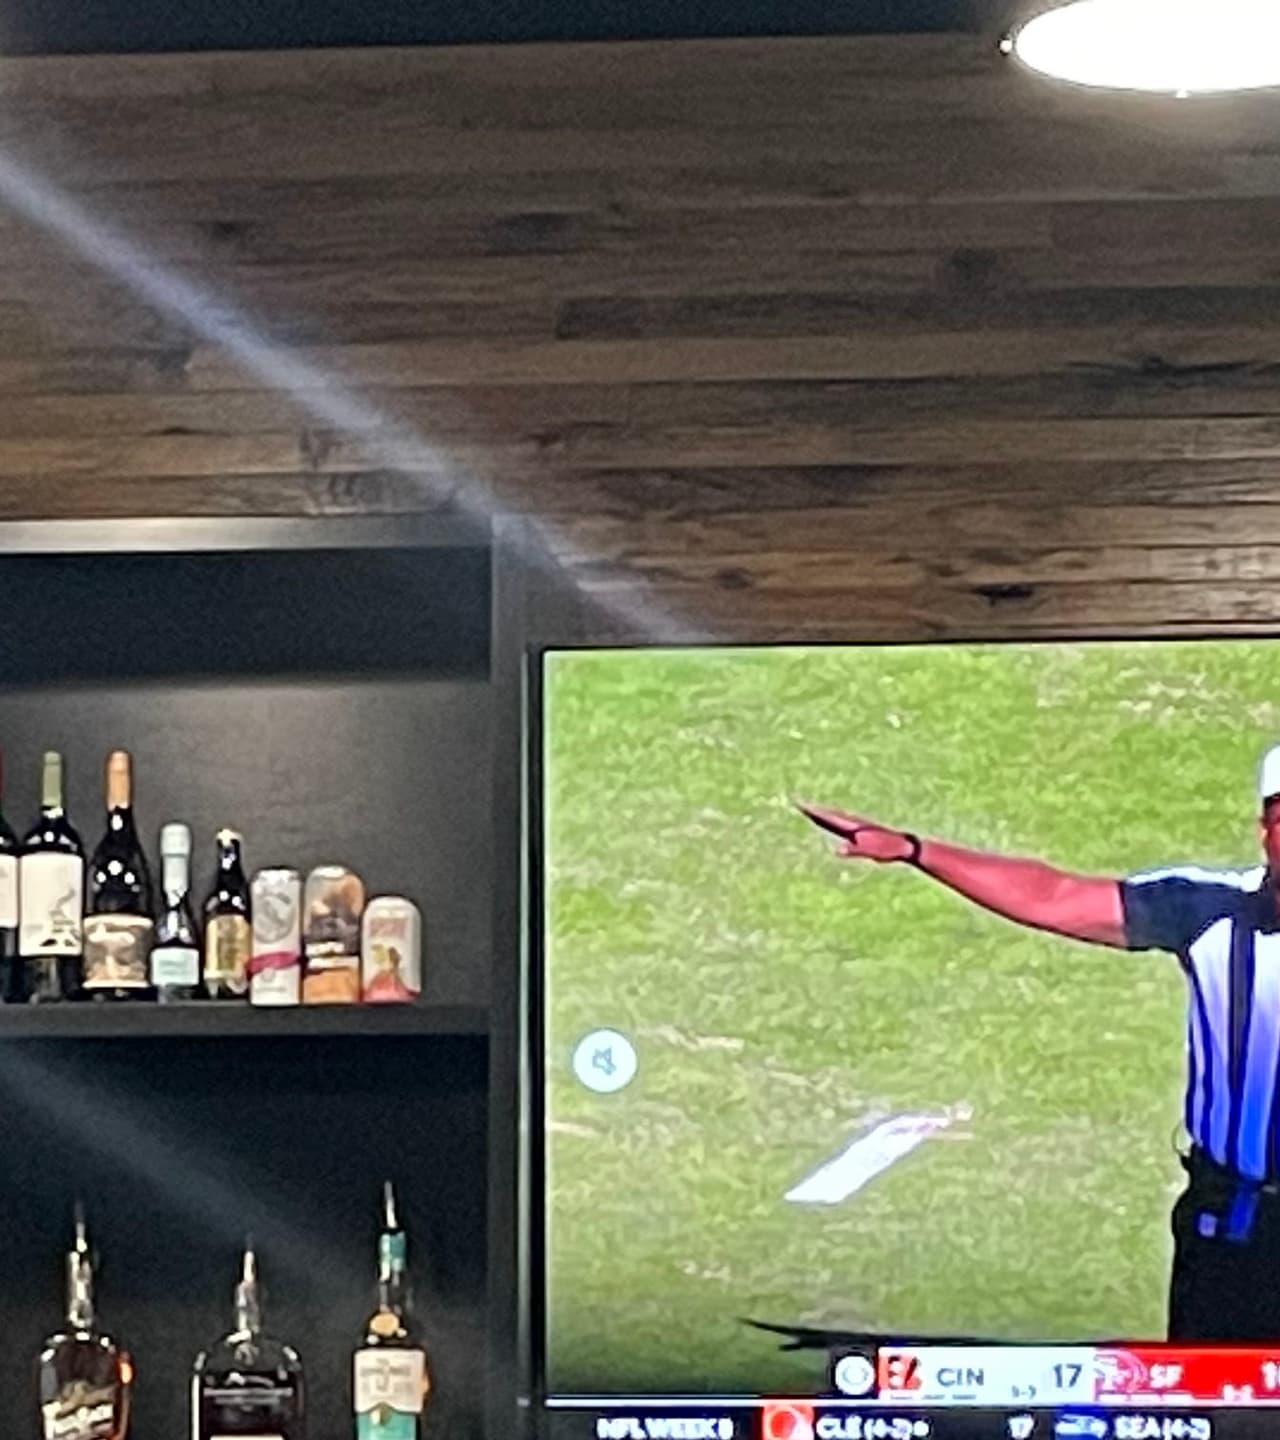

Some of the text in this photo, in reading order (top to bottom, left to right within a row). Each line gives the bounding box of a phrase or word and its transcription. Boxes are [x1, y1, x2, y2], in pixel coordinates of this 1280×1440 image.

[936, 1367, 985, 1388] CIN
[1052, 1362, 1083, 1388] 17
[1148, 1363, 1184, 1389] SF
[646, 1416, 718, 1440] WEEK
